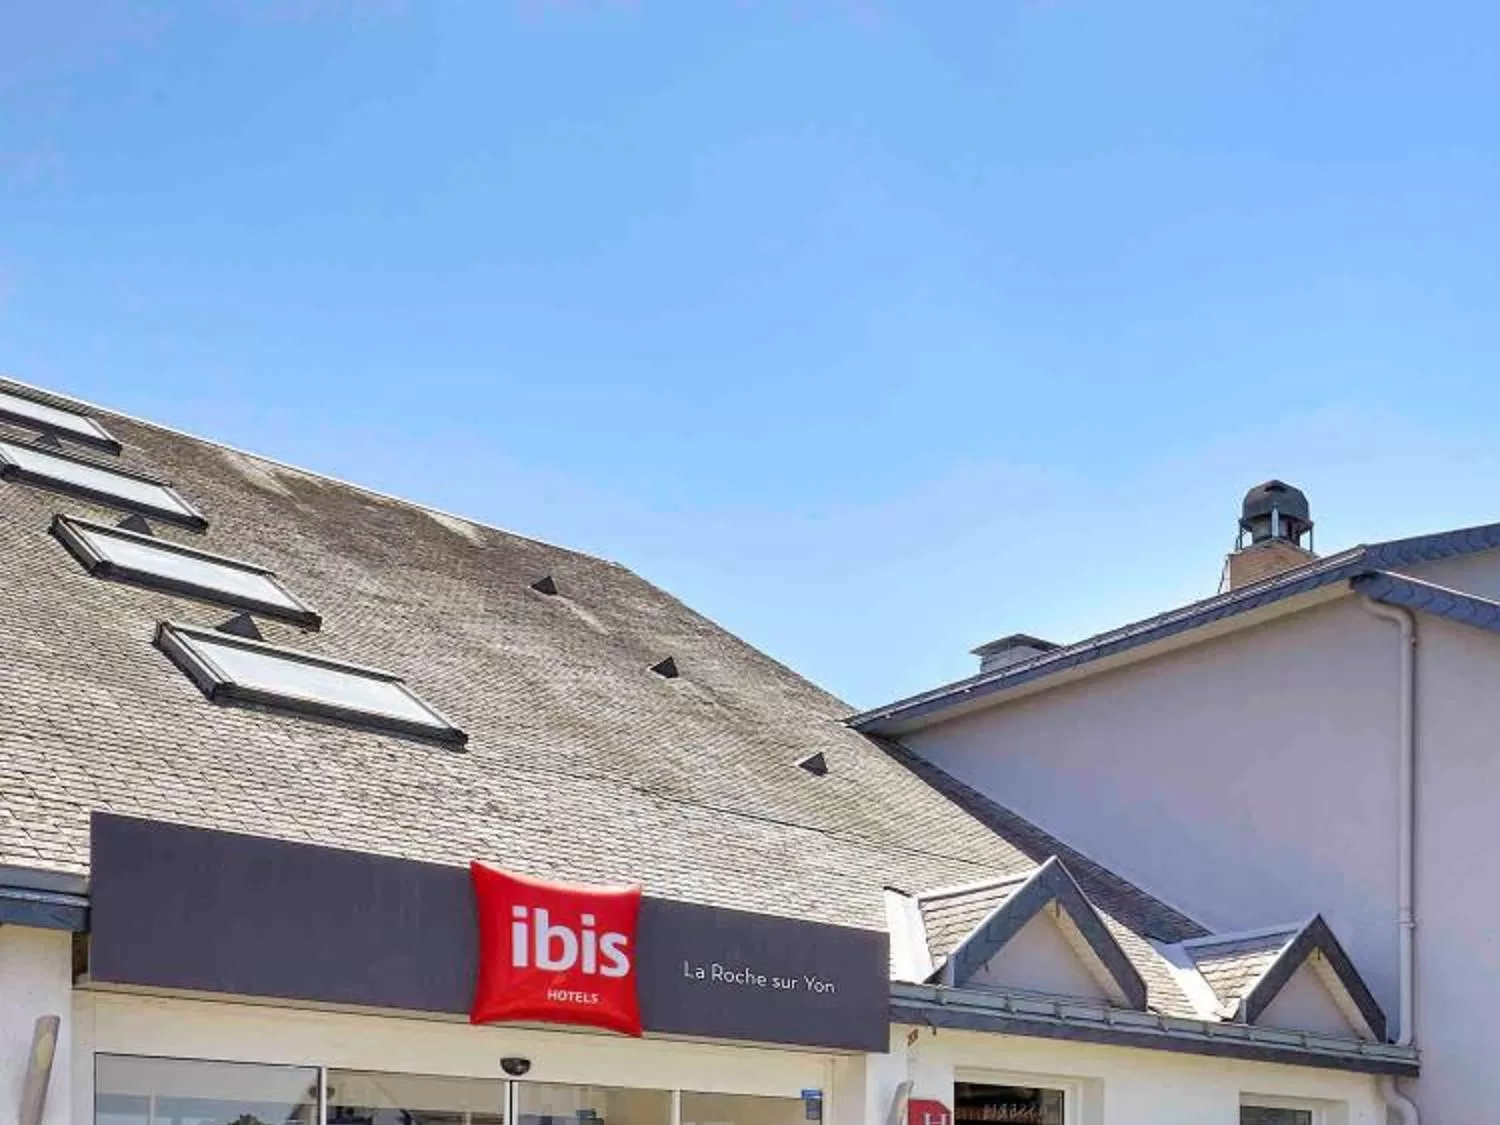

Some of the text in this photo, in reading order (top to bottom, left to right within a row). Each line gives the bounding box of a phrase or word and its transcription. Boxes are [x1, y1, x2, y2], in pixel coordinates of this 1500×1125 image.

[511, 905, 631, 978] ibis
[683, 959, 836, 993] La Roche sur Yon
[547, 988, 600, 1004] HOTELS
